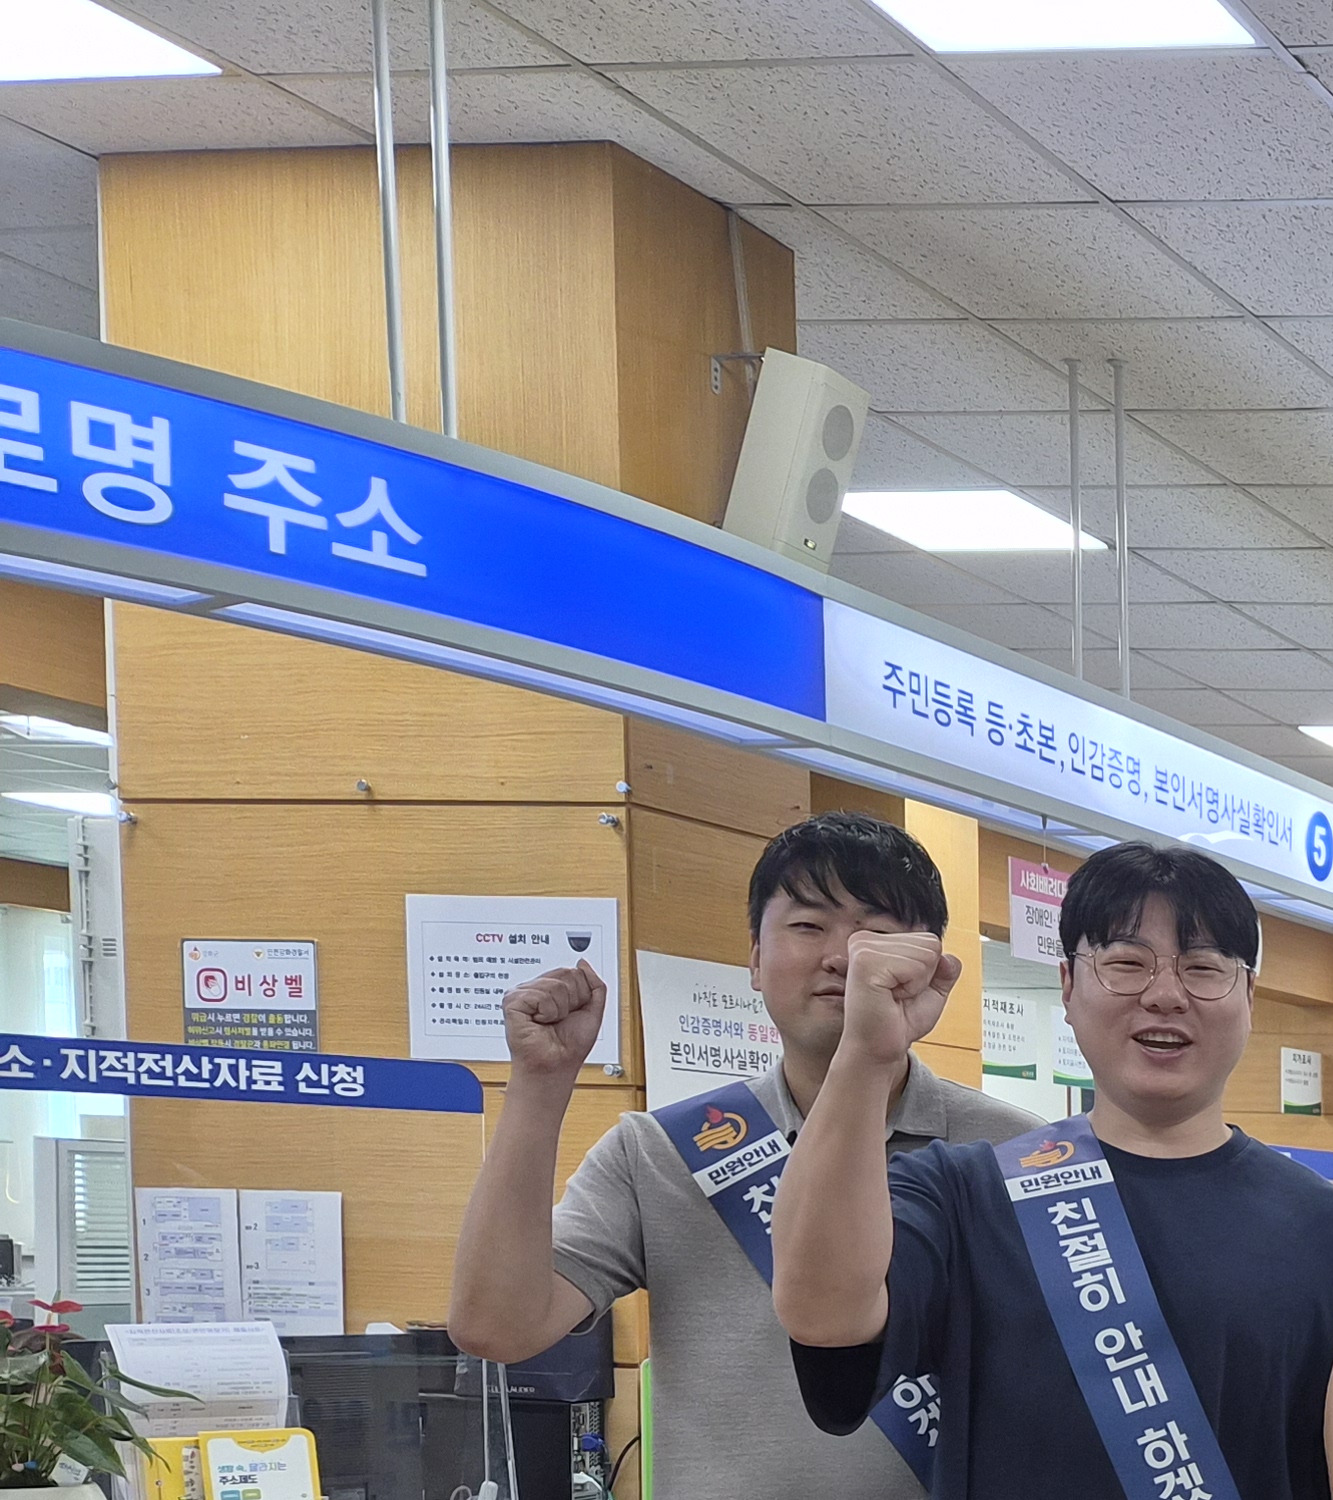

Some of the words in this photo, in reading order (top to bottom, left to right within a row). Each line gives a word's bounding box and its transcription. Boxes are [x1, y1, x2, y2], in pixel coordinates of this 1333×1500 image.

[223, 438, 428, 579] 주소
[882, 659, 977, 737] 주민등록
[1152, 763, 1294, 854] 본인서명사실확인서
[475, 933, 504, 943] CCTV
[508, 934, 526, 944] 설치
[531, 934, 550, 945] 안내
[234, 973, 303, 998] 비상벨
[692, 990, 718, 1008] 아직도
[983, 997, 1025, 1018] 지적재조사
[275, 1027, 283, 1036] 수
[678, 1014, 744, 1040] 인감증명서와
[748, 1023, 780, 1044] 동일한
[670, 1041, 779, 1073] 본인서명사실확인
[296, 1066, 365, 1097] 신청
[707, 1138, 782, 1186] 민원안내
[1019, 1166, 1103, 1194] 민원안내
[1047, 1197, 1127, 1313] 친절히
[1094, 1320, 1169, 1415] 안내
[218, 1474, 258, 1485] 주소제도
[248, 1461, 288, 1472] 달라지는
